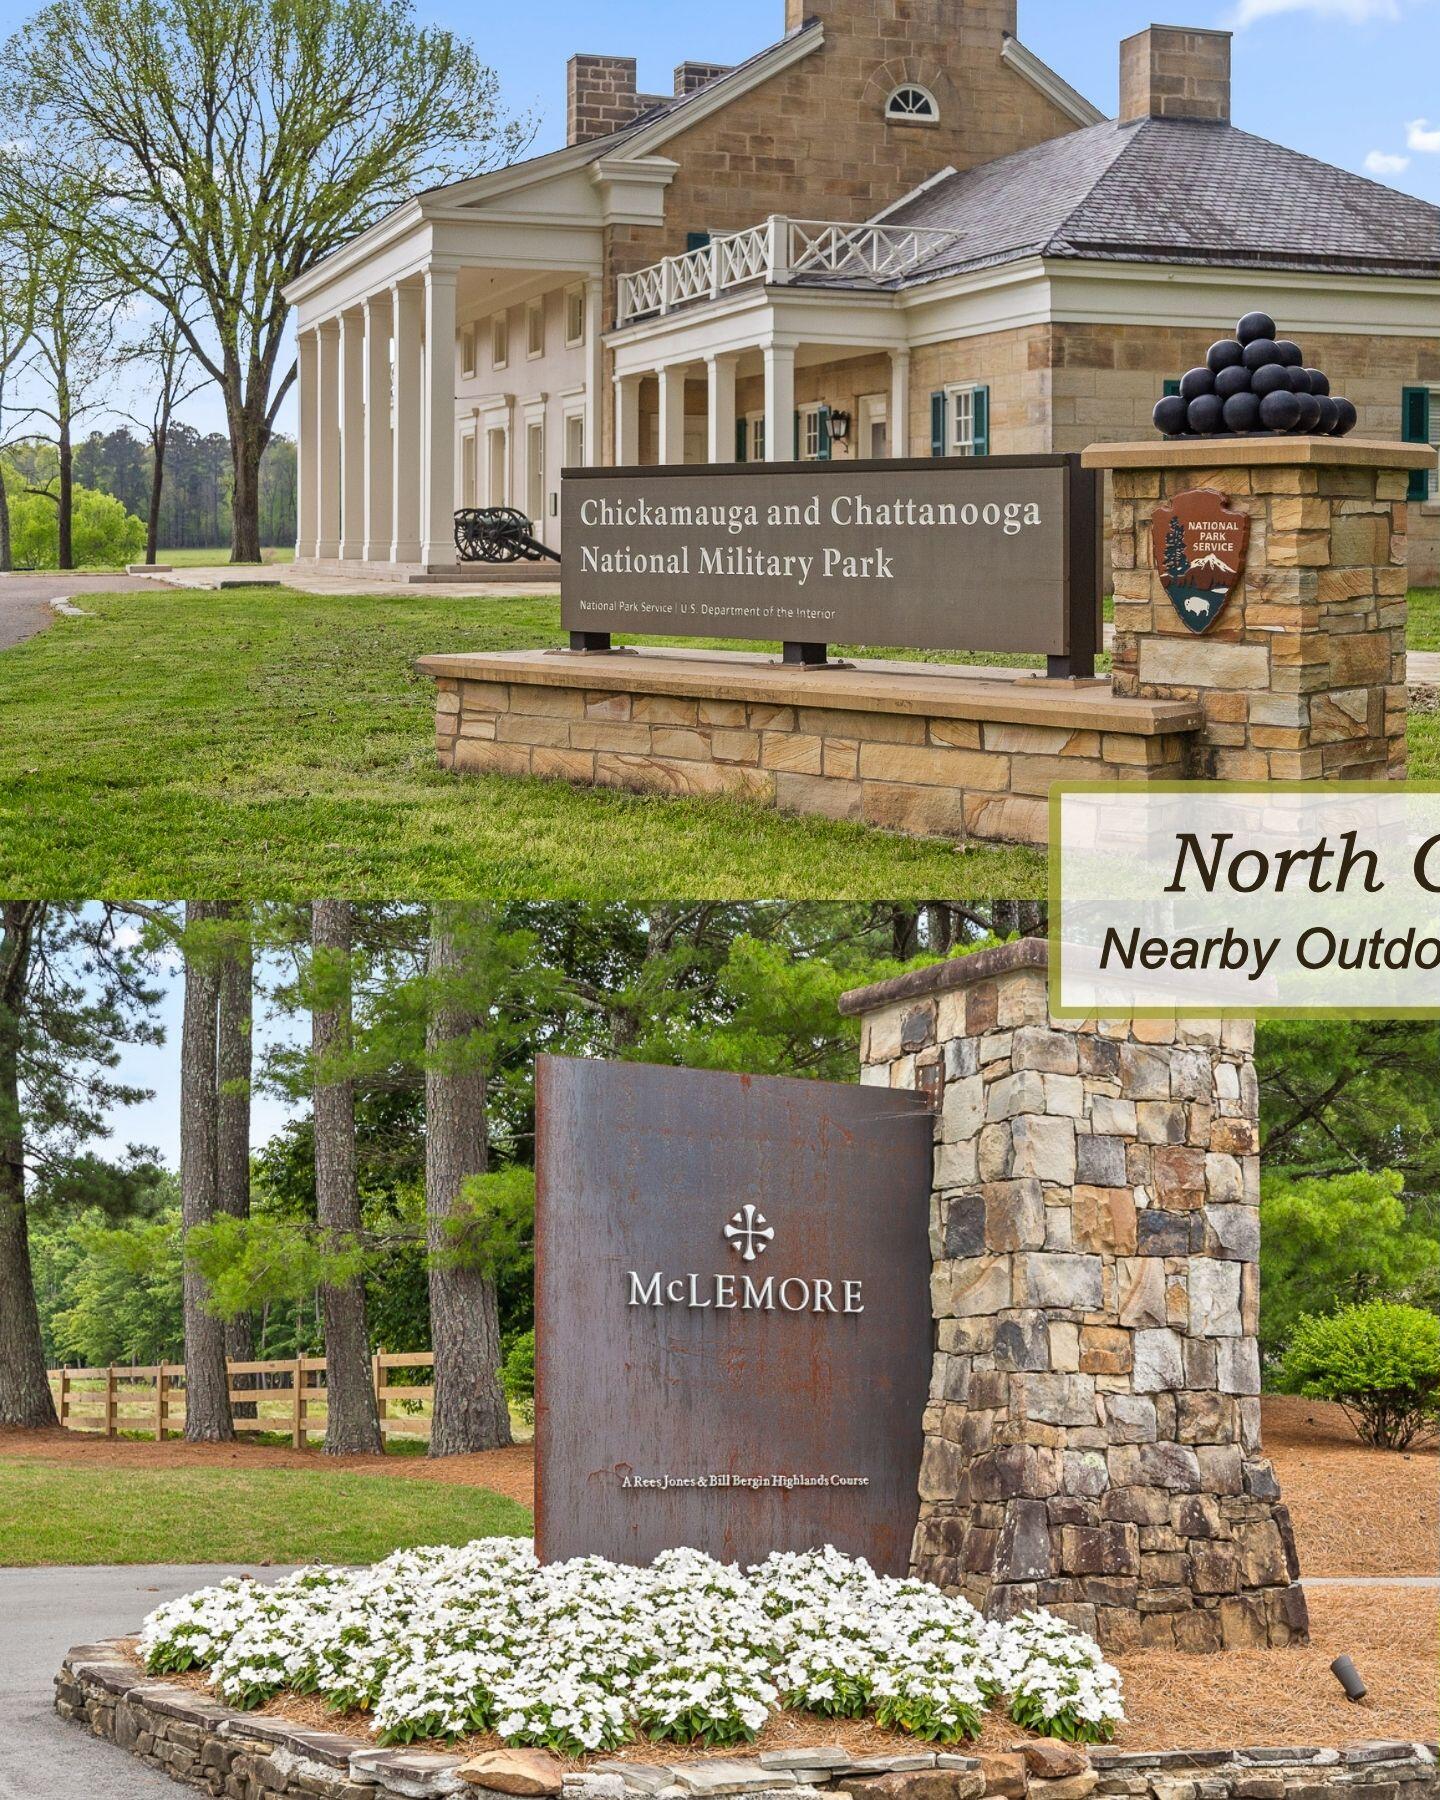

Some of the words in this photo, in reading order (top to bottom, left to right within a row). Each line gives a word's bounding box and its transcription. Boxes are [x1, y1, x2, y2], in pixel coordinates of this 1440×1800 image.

[580, 498, 758, 533] Chickamauga
[767, 496, 821, 527] and
[831, 495, 1042, 536] Chattanooga
[1188, 521, 1238, 530] NATIONAL
[1200, 532, 1226, 541] PARK
[1193, 542, 1234, 552] SERVICE
[580, 545, 690, 575] National
[699, 546, 813, 586] Military
[822, 547, 894, 579] Park
[580, 600, 617, 612] National
[619, 601, 639, 612] Park
[641, 602, 673, 613] Service
[701, 604, 760, 618] Department
[763, 606, 774, 617] of
[777, 607, 794, 618] the
[797, 608, 836, 620] Interior
[622, 1476, 632, 1488] A
[634, 1476, 662, 1488] Rees
[661, 1475, 696, 1490] Jones
[697, 1477, 708, 1488] &
[709, 1475, 730, 1487] Bill
[732, 1476, 770, 1490] Bergin
[771, 1475, 829, 1490] Highlands
[830, 1475, 869, 1487] Course
